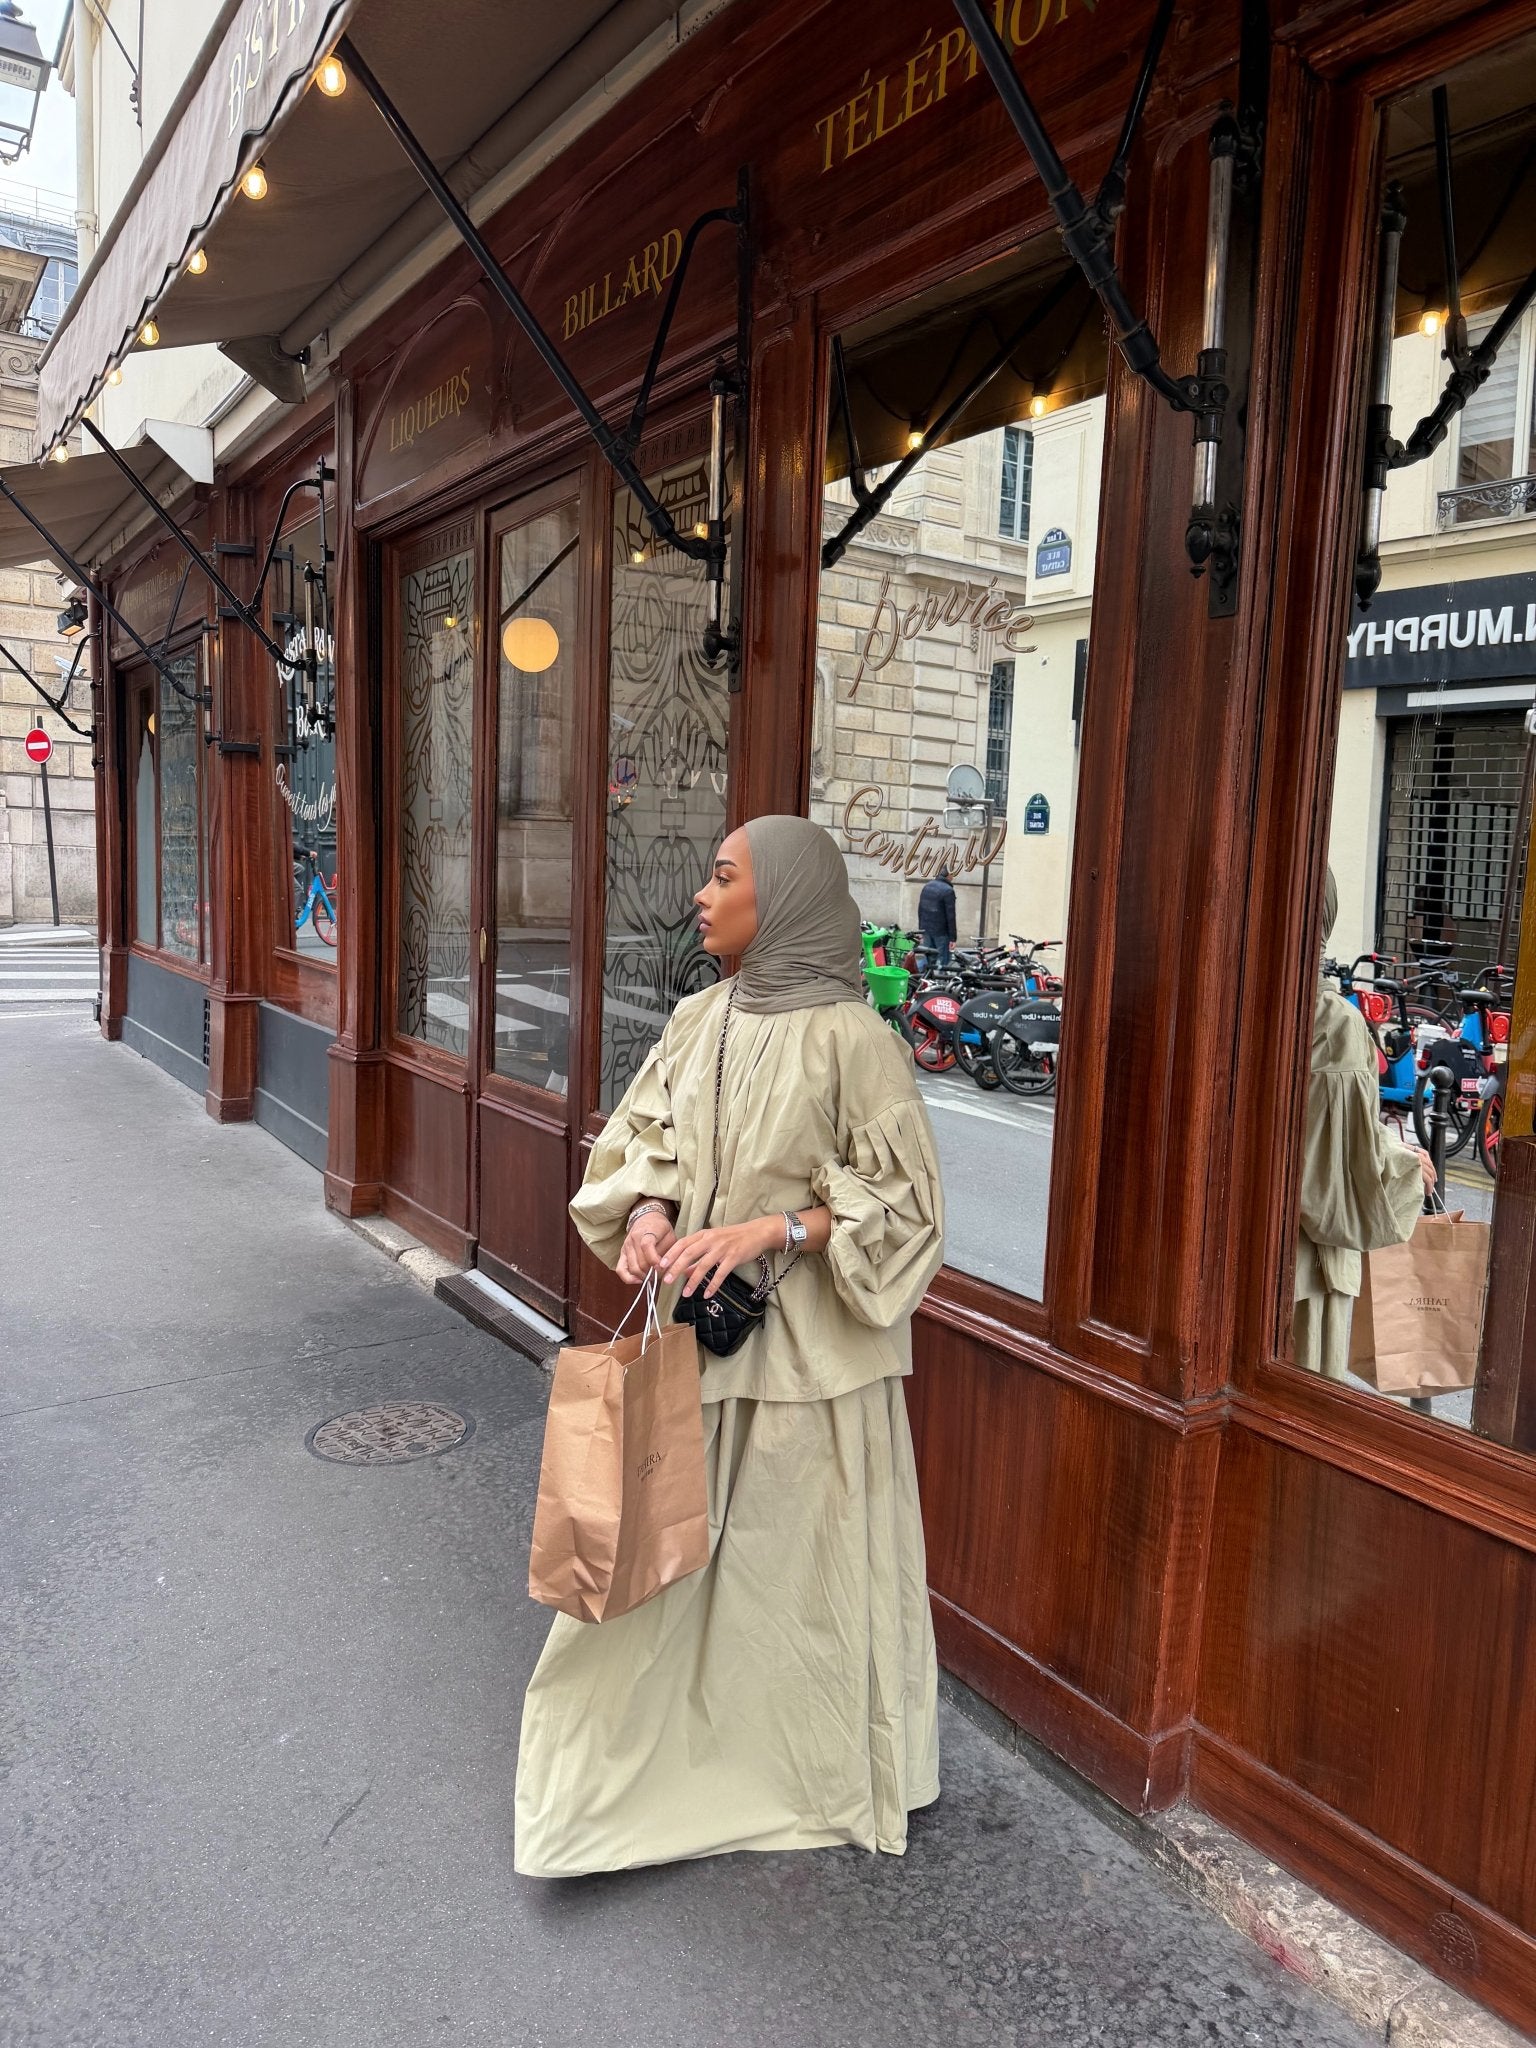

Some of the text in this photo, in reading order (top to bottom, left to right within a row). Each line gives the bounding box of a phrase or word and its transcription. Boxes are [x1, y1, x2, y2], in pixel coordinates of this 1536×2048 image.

[561, 228, 683, 341] BILLARD
[390, 364, 471, 452] LIQUEURS
[846, 571, 1038, 697] Service
[842, 785, 1007, 878] Continu
